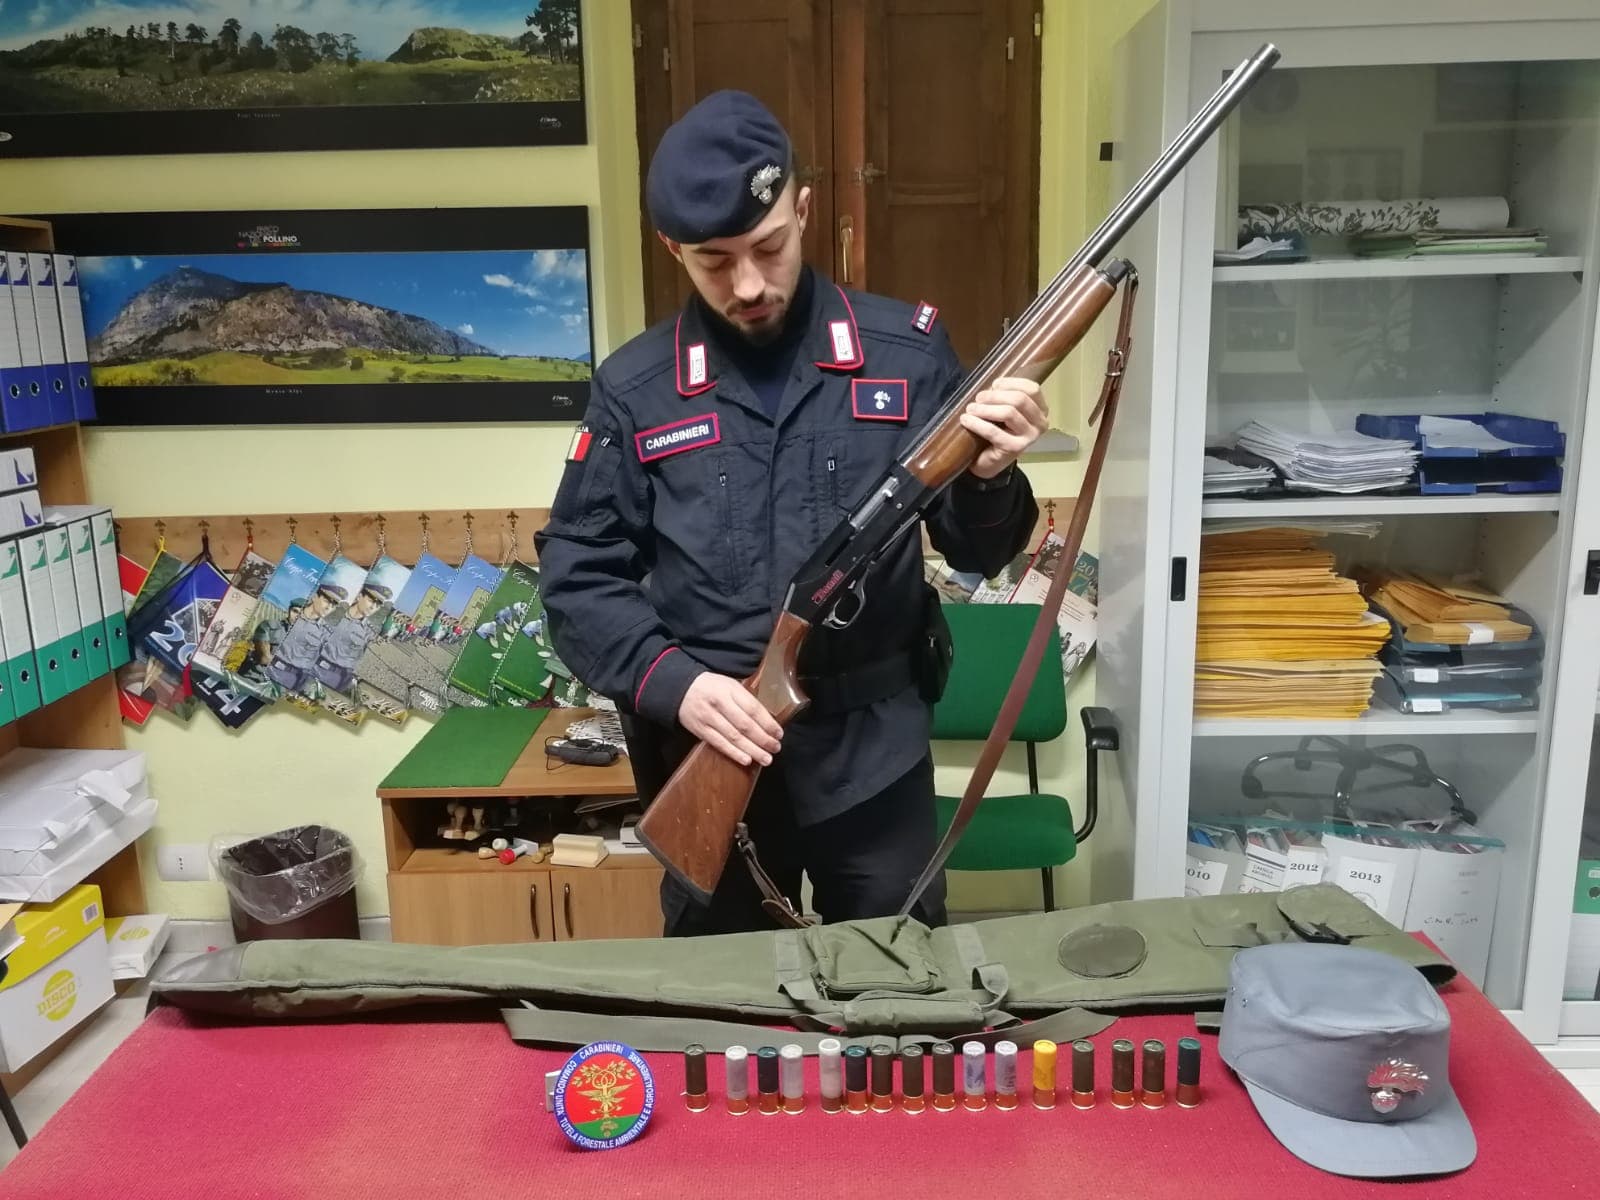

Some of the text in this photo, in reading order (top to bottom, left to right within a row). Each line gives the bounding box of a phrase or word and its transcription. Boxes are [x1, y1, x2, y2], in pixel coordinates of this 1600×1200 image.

[263, 235, 298, 243] POLLINO
[646, 423, 710, 450] CARABINIERI
[1290, 862, 1320, 872] 2012
[1349, 869, 1382, 884] 2013
[36, 981, 76, 1017] DISCO
[579, 1043, 624, 1060] CARABINIERI
[556, 1059, 578, 1094] COMANDO
[560, 1117, 578, 1139] TUTELA
[615, 1114, 648, 1147] AMBIENTALE
[576, 1135, 615, 1149] FORESTALE
